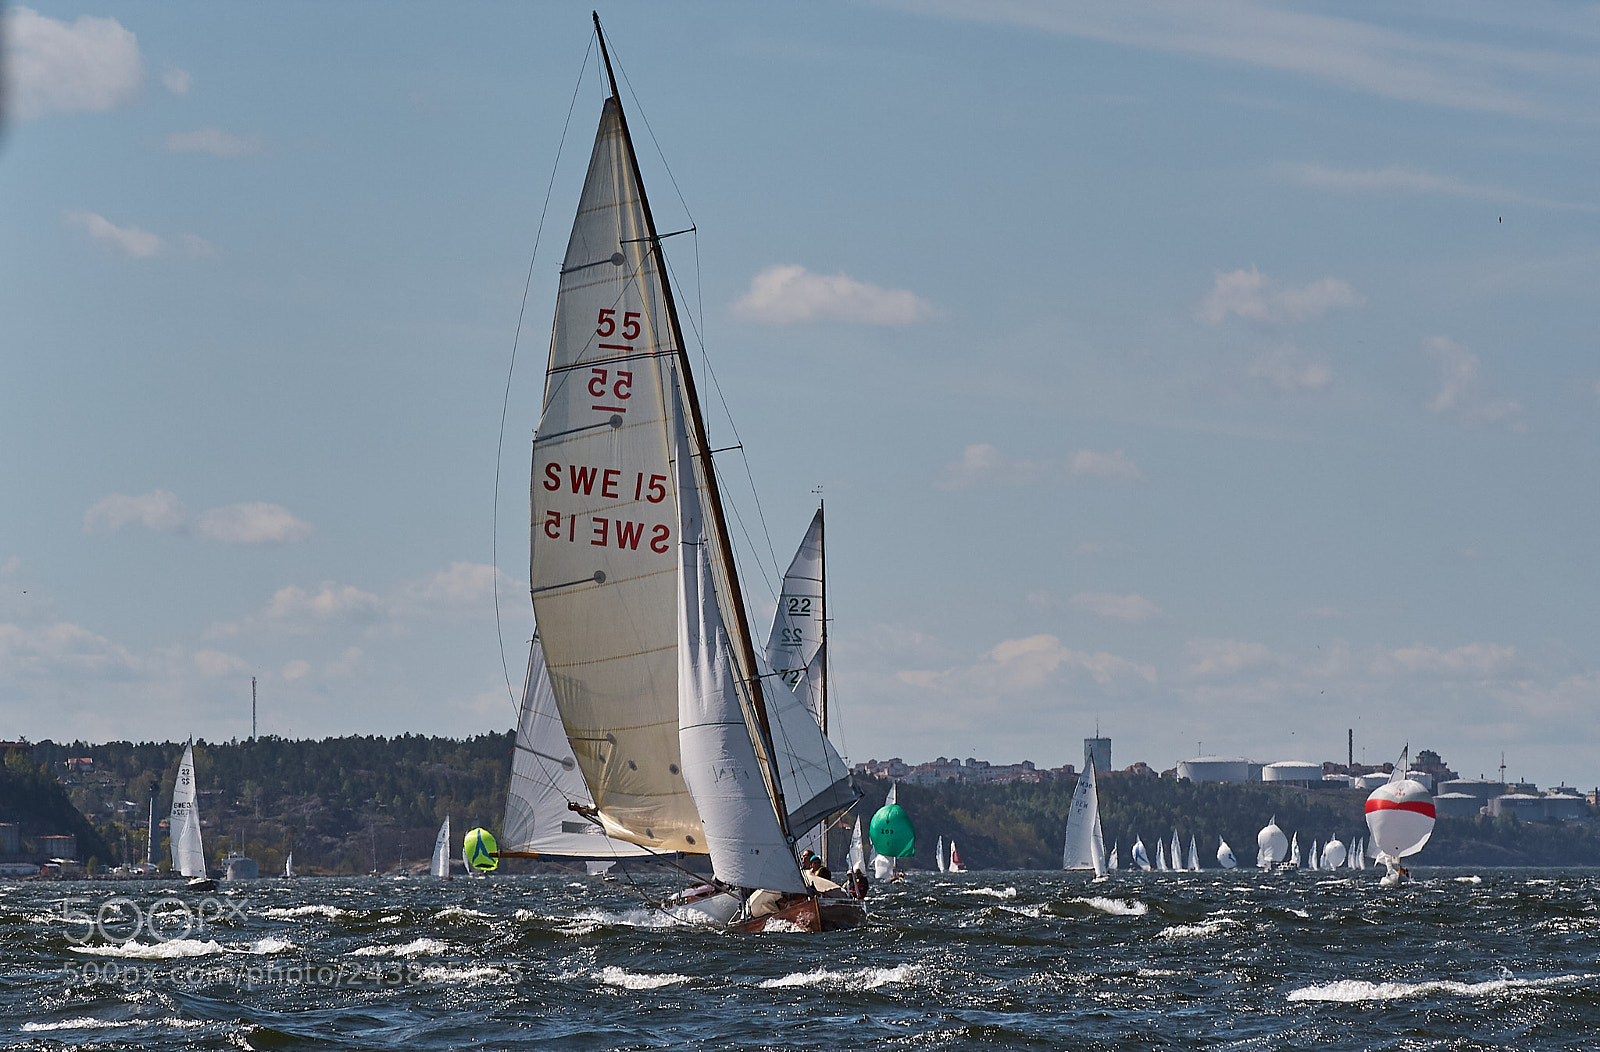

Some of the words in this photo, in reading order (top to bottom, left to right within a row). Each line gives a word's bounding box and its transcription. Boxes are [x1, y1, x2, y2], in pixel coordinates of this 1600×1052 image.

[597, 308, 641, 340] 55
[543, 462, 621, 499] SWE
[635, 472, 667, 503] 15
[788, 598, 811, 613] 22
